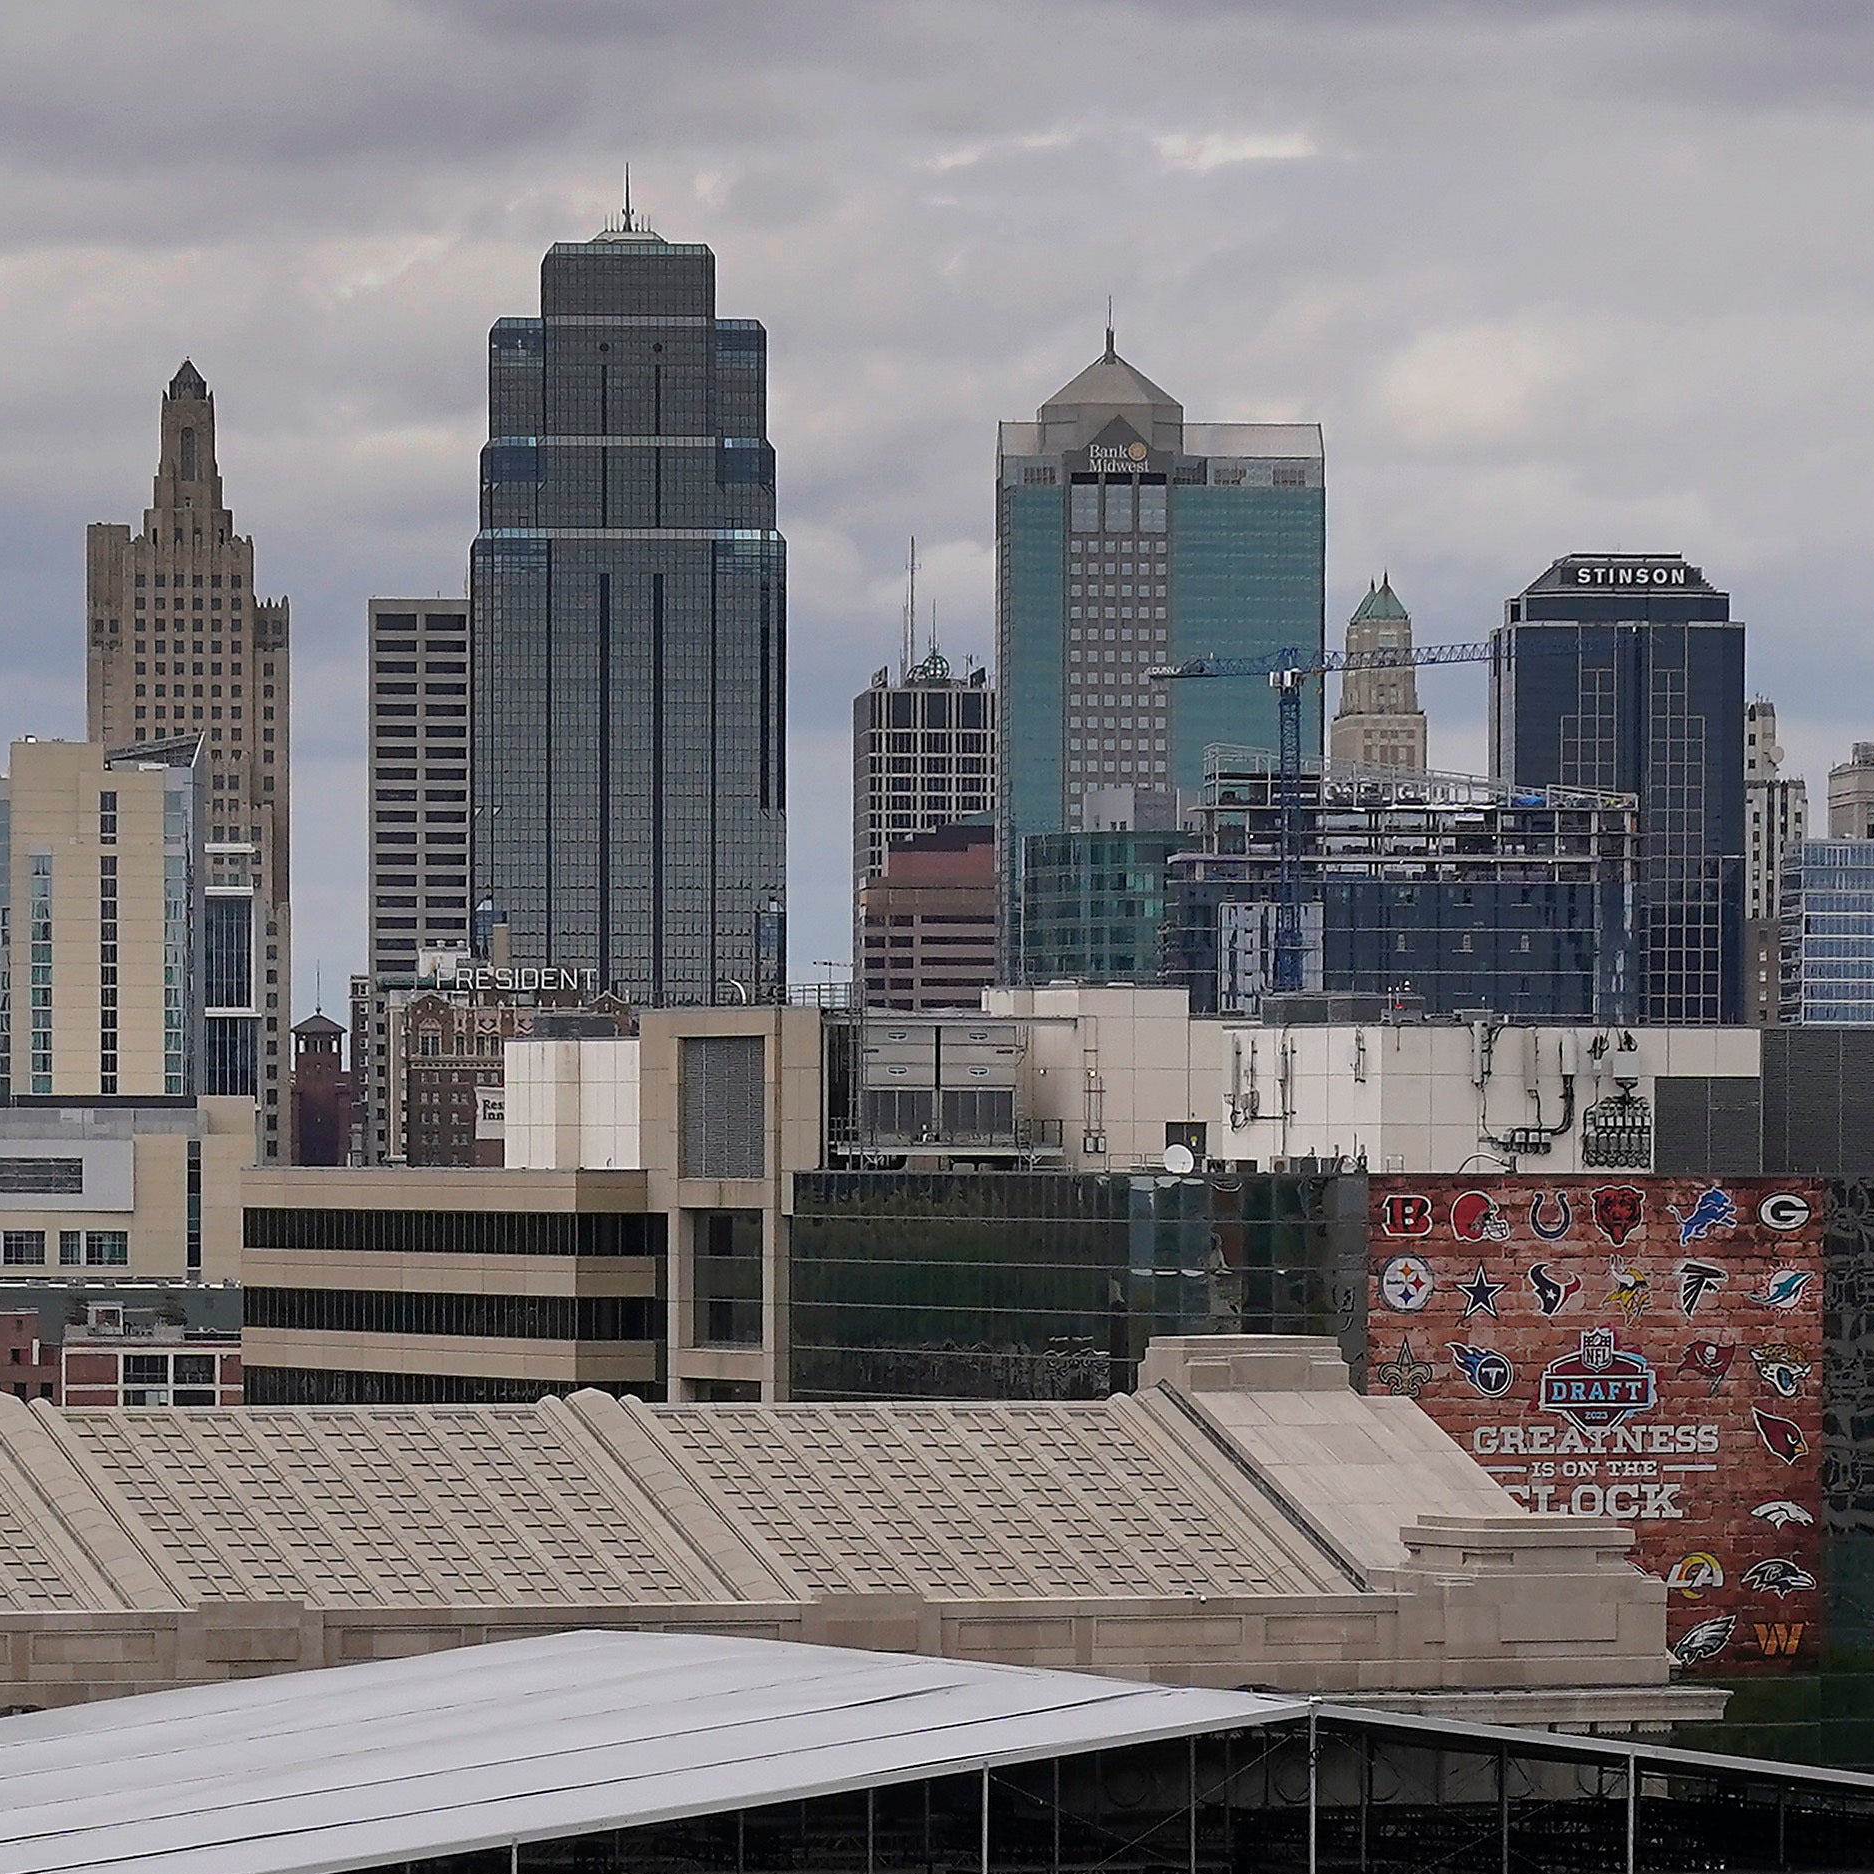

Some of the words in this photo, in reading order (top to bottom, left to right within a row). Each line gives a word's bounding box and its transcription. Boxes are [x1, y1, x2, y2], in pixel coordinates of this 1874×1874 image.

[1089, 444, 1128, 458] Bank
[1089, 459, 1149, 473] Midwest
[1577, 567, 1685, 585] STINSON
[436, 967, 597, 990] PRESIDENT
[482, 1110, 504, 1120] Inn
[1585, 1348, 1608, 1366] NFL
[1551, 1381, 1643, 1401] DRAFT
[1584, 1411, 1609, 1421] 2023
[1473, 1423, 1720, 1454] GREATNESS
[1531, 1461, 1555, 1478] IS
[1562, 1461, 1599, 1477] ON
[1606, 1460, 1657, 1477] THE
